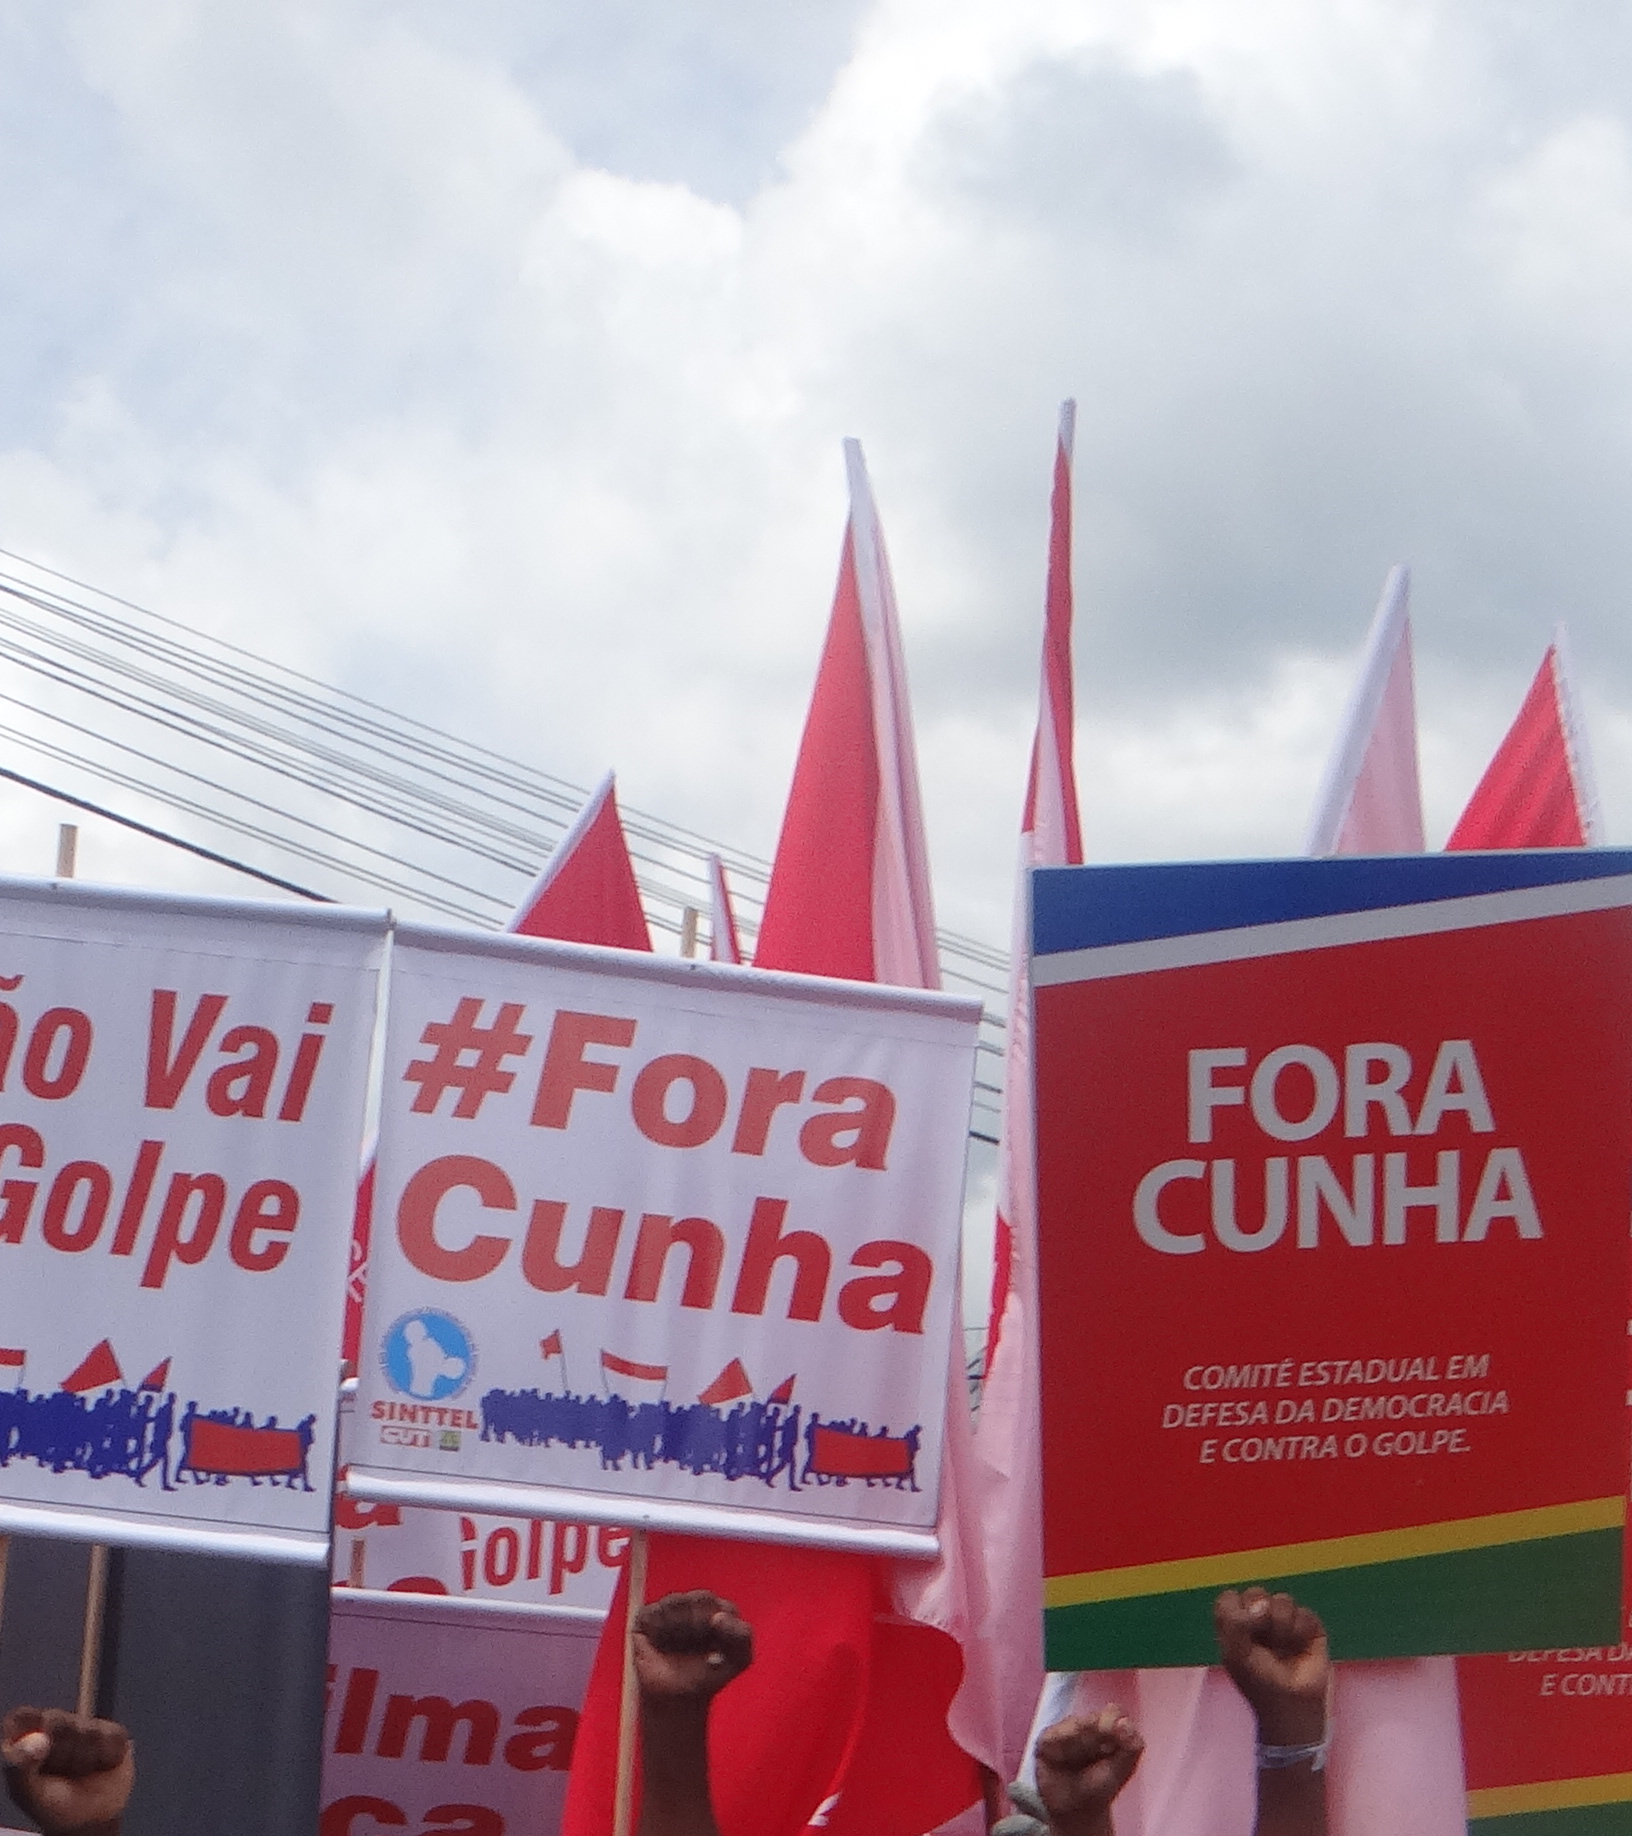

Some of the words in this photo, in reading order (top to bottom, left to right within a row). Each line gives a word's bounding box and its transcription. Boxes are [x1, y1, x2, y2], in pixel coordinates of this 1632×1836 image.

[143, 989, 335, 1123] Vai
[404, 997, 898, 1172] #Fora
[1187, 1039, 1497, 1144] FORA
[1131, 1147, 1544, 1256] CUNHA
[395, 1154, 935, 1336] Cunha
[1298, 1357, 1441, 1388] ESTADUAL
[1446, 1353, 1491, 1382] EM
[371, 1400, 478, 1430] SINTTEL
[1161, 1401, 1269, 1430] DEFESA
[1275, 1399, 1315, 1425] DA
[1321, 1390, 1511, 1423] DEMOCRACIA
[1199, 1439, 1219, 1464] E
[1221, 1435, 1339, 1463] CONTRA
[1344, 1432, 1367, 1458] O
[1372, 1428, 1471, 1457] GOLPE.
[1540, 1673, 1558, 1695] E
